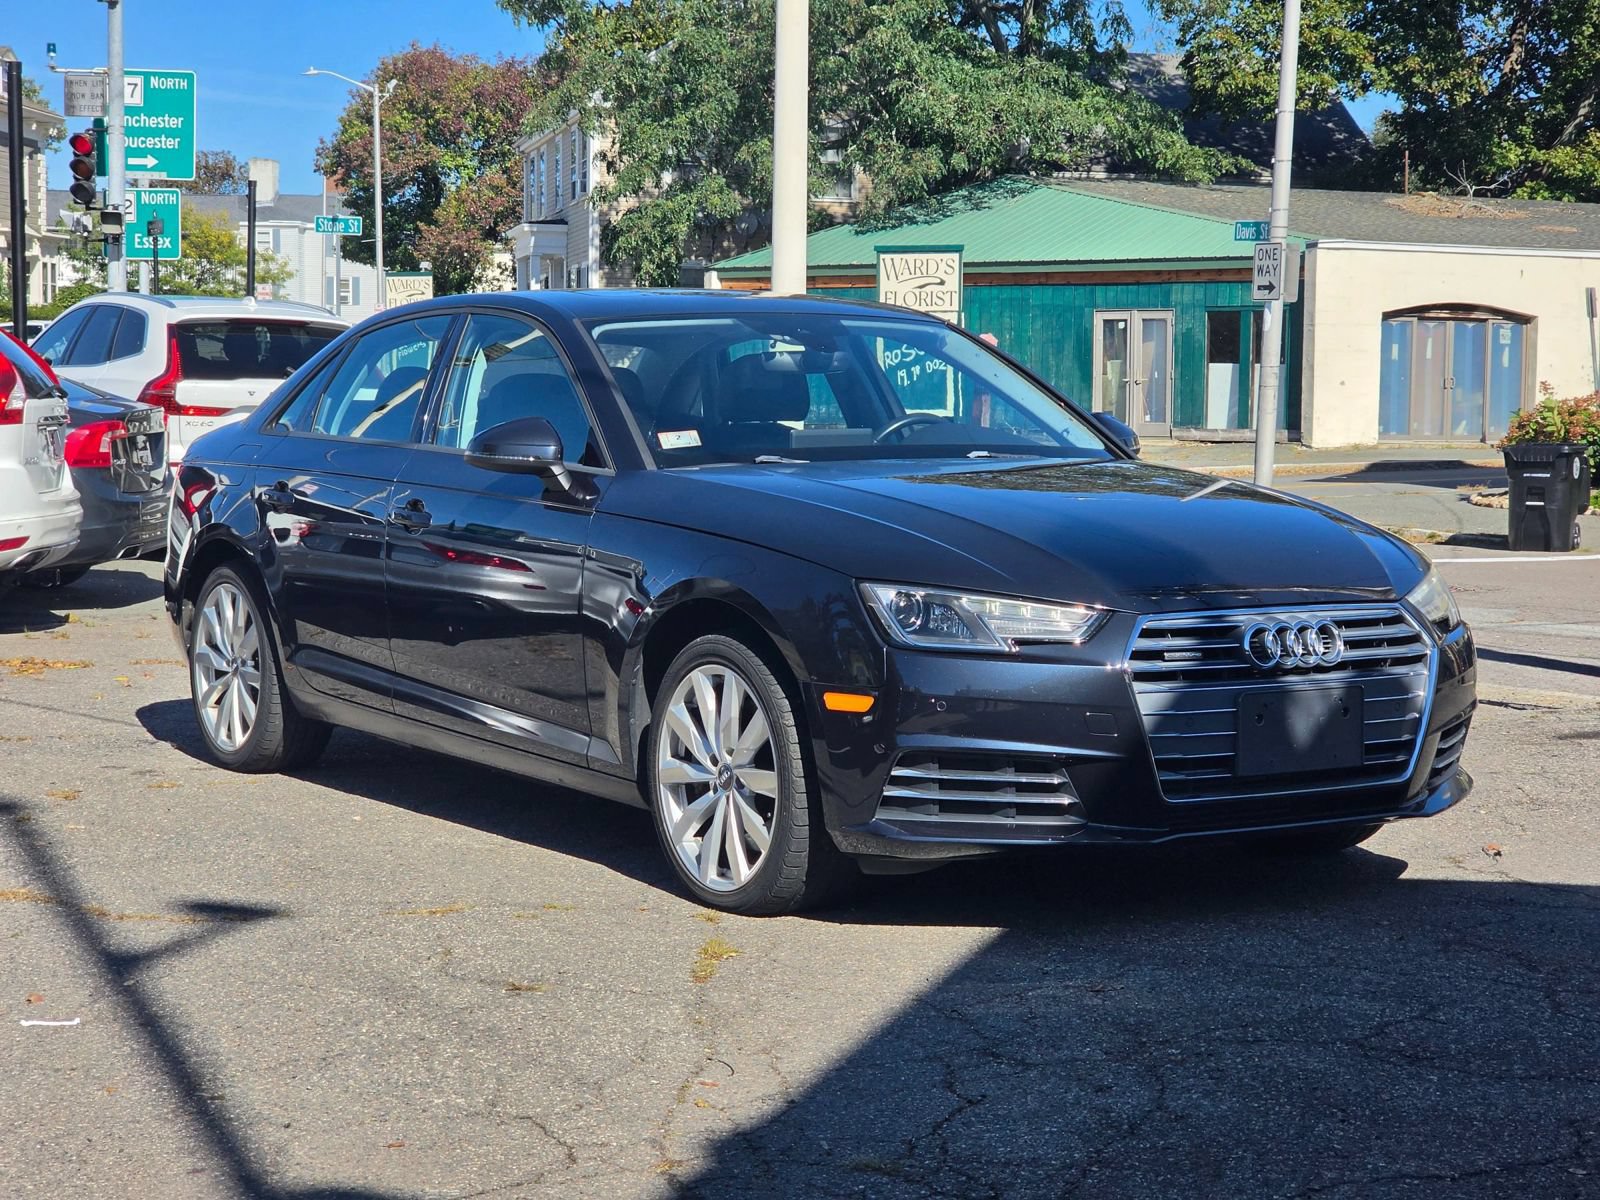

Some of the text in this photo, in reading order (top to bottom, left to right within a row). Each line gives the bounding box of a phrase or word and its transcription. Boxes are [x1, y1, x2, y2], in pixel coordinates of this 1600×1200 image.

[150, 76, 188, 90] NORTH
[104, 113, 184, 128] nchester
[107, 134, 180, 149] oucester
[141, 192, 177, 205] NORTH
[318, 218, 359, 233] Stone St
[1236, 223, 1269, 239] Davis St
[134, 233, 172, 249] Essex
[1257, 248, 1279, 261] ONE
[882, 257, 956, 281] WARD'S
[1257, 264, 1279, 277] WAY
[387, 279, 430, 292] WARD'S
[884, 290, 957, 307] FLORIST
